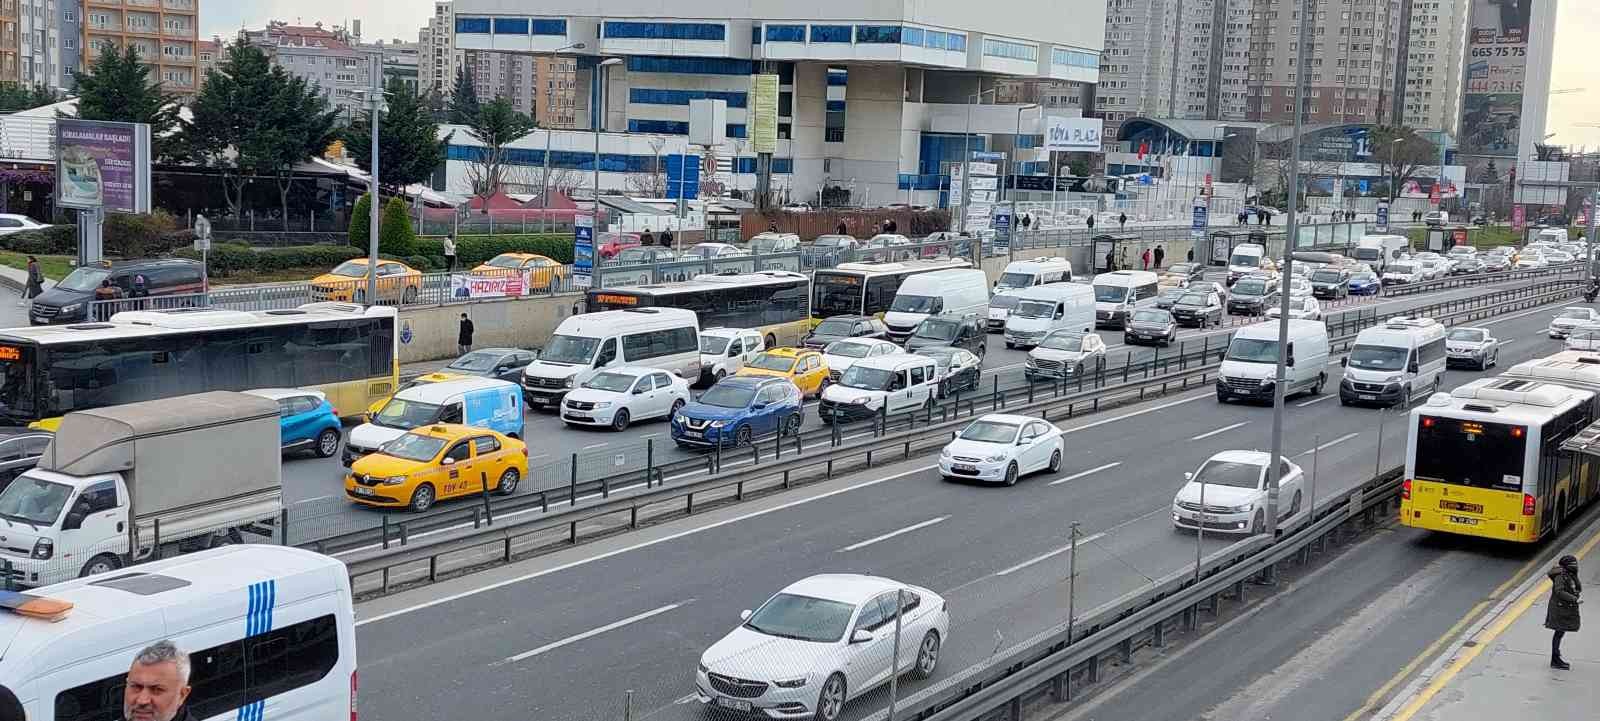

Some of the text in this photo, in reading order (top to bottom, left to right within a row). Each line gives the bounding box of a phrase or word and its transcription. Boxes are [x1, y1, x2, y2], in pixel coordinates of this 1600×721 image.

[1472, 47, 1526, 57] 665 75 75
[1073, 128, 1099, 142] PLAZA
[470, 280, 506, 294] HAZIRIZ
